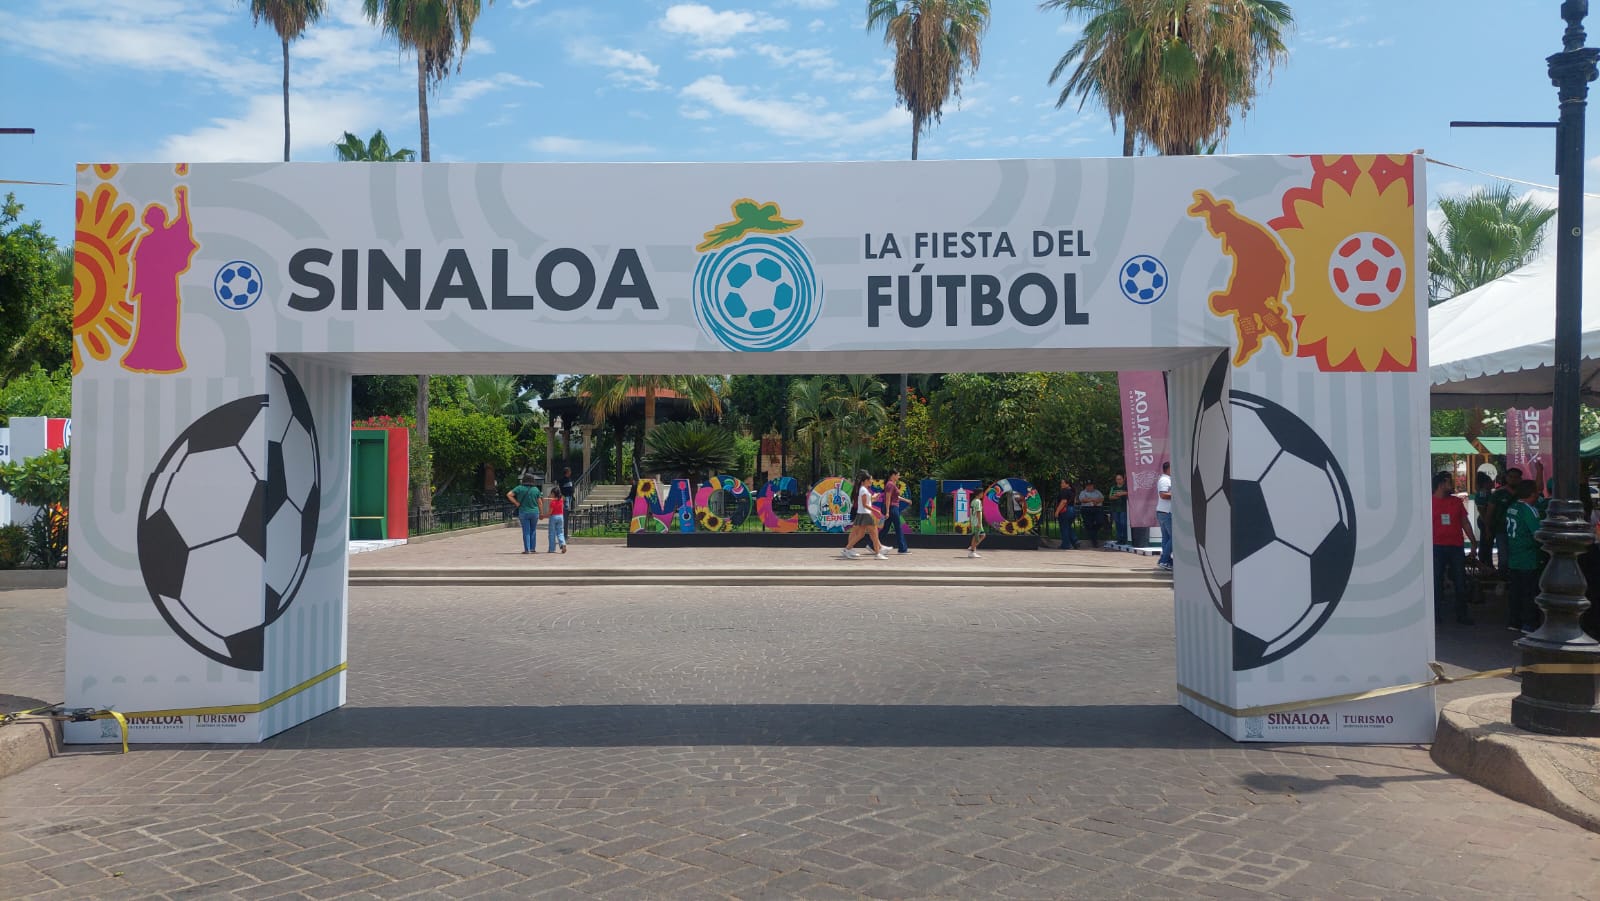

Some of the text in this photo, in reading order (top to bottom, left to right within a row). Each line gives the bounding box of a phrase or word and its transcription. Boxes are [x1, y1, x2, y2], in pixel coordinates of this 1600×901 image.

[865, 230, 1091, 259] LA FIESTA DEL
[287, 247, 660, 311] SINALOA
[866, 263, 1090, 328] FÚTBOL
[196, 714, 246, 724] TURISMO
[1268, 713, 1330, 725] SINALOA
[1343, 715, 1394, 724] TURISMO
